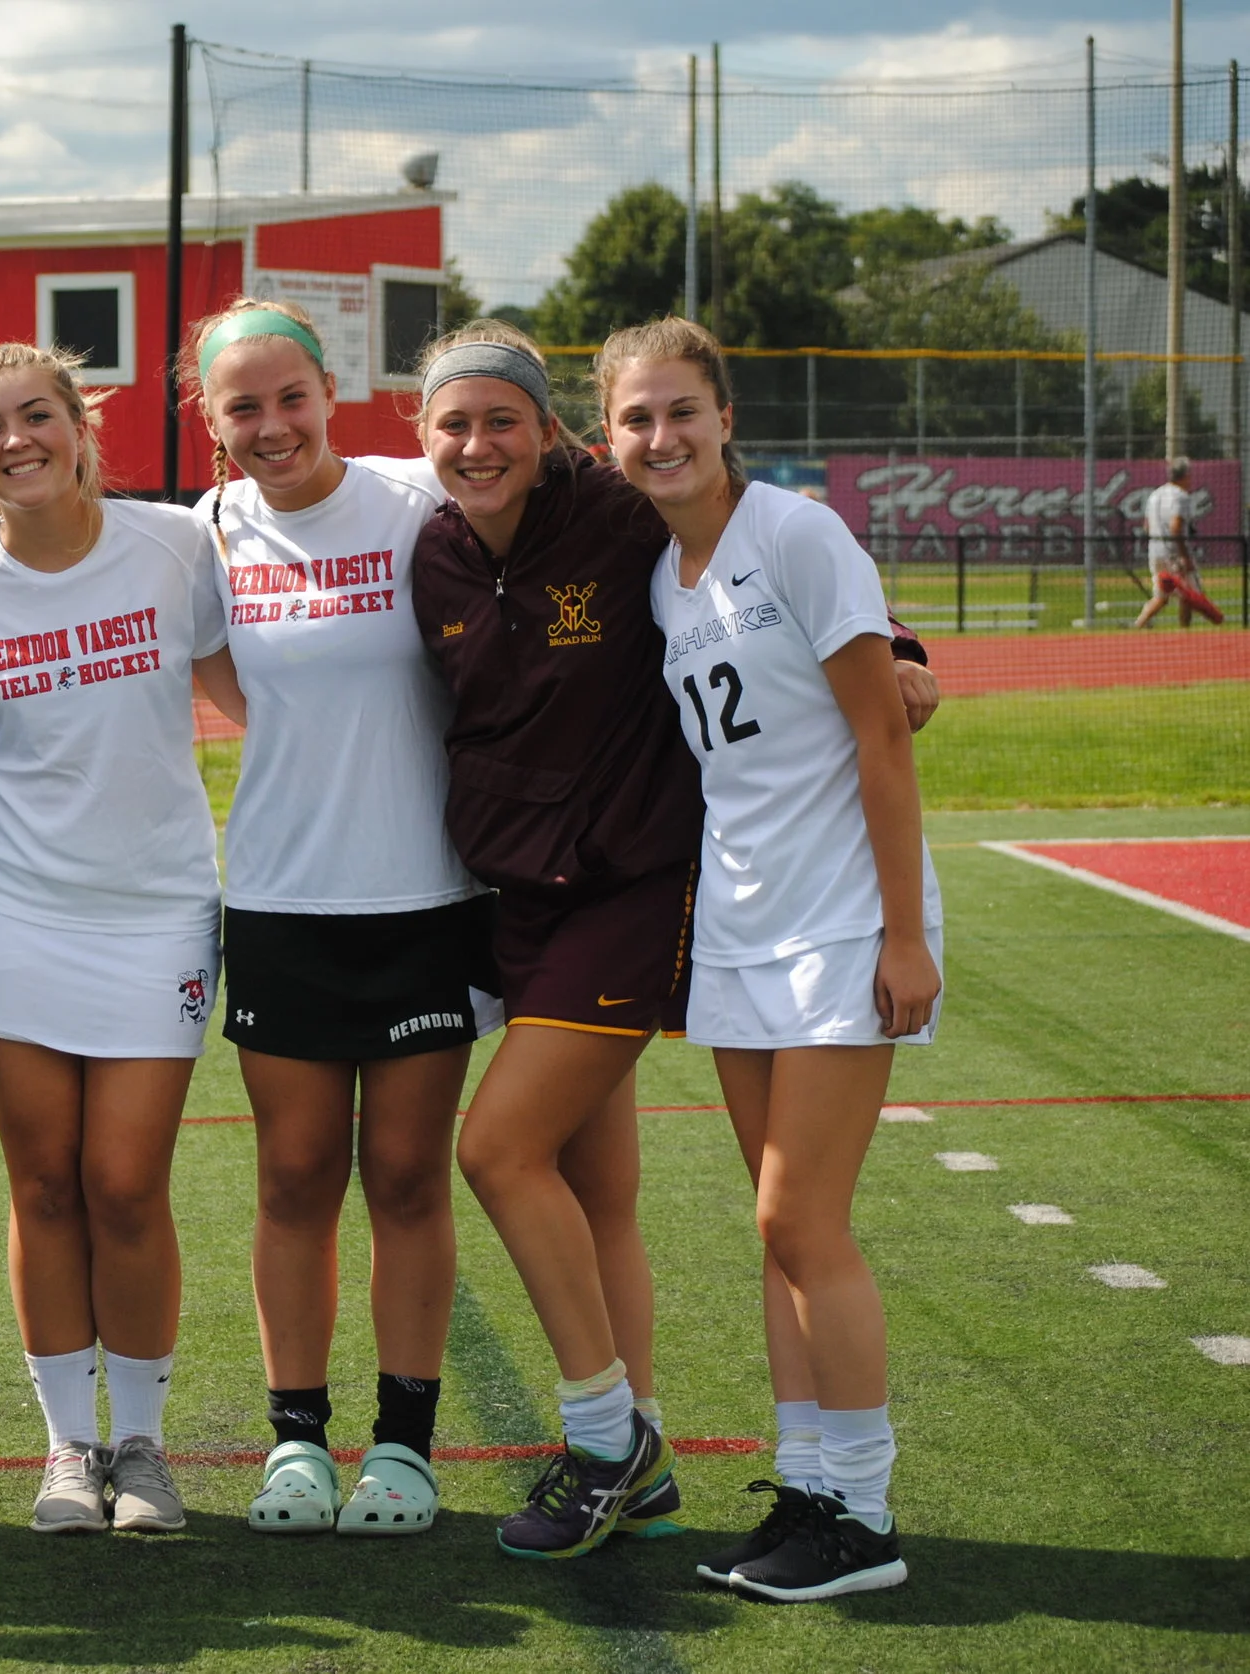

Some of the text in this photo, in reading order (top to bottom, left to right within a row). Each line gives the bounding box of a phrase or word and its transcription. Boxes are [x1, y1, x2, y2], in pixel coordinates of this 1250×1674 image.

[868, 522, 1204, 561] BASEBAL
[229, 549, 393, 597] HERNDON VARSITY
[230, 589, 394, 625] FIELD HOCKEY
[75, 607, 158, 655] VARSITY
[548, 633, 602, 647] BROAD RUN
[78, 649, 161, 686] HOCKEY
[683, 661, 762, 752] 12
[389, 1012, 464, 1043] HERNDON
